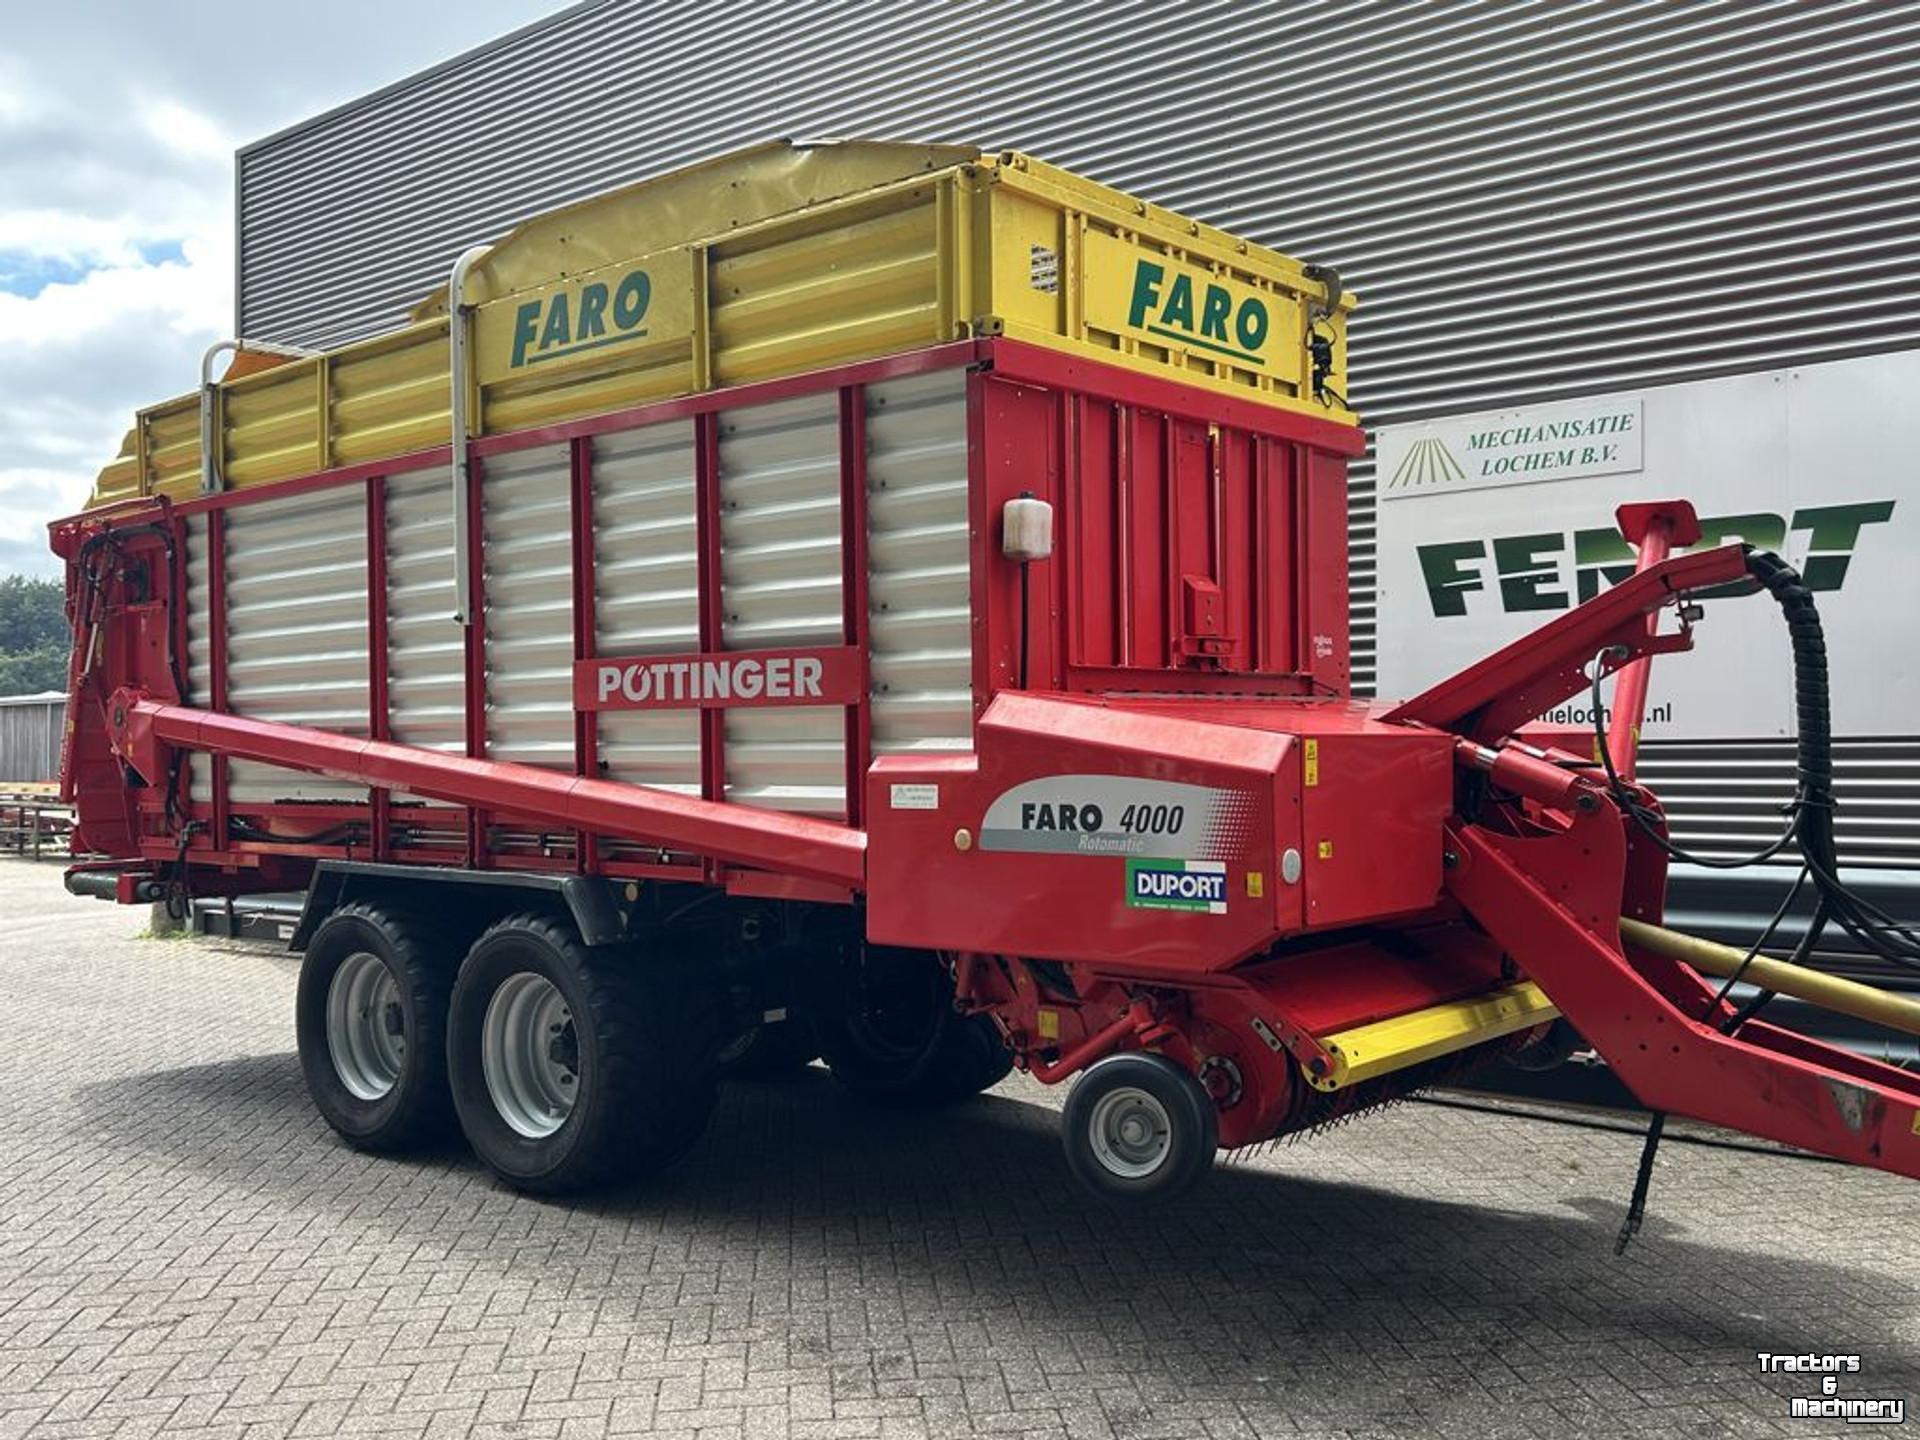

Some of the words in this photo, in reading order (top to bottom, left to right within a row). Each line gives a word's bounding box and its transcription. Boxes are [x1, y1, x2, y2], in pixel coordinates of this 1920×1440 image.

[510, 270, 651, 368] FARO
[1128, 258, 1268, 350] FARO
[1467, 413, 1635, 451] MECHANISATIE
[1481, 448, 1575, 476] LOCHEM
[1580, 444, 1618, 464] B.V.
[1021, 802, 1103, 832] FARO
[1119, 804, 1185, 835] 4000
[1078, 833, 1145, 853] Rotomatic
[1137, 871, 1224, 899] DUPORT
